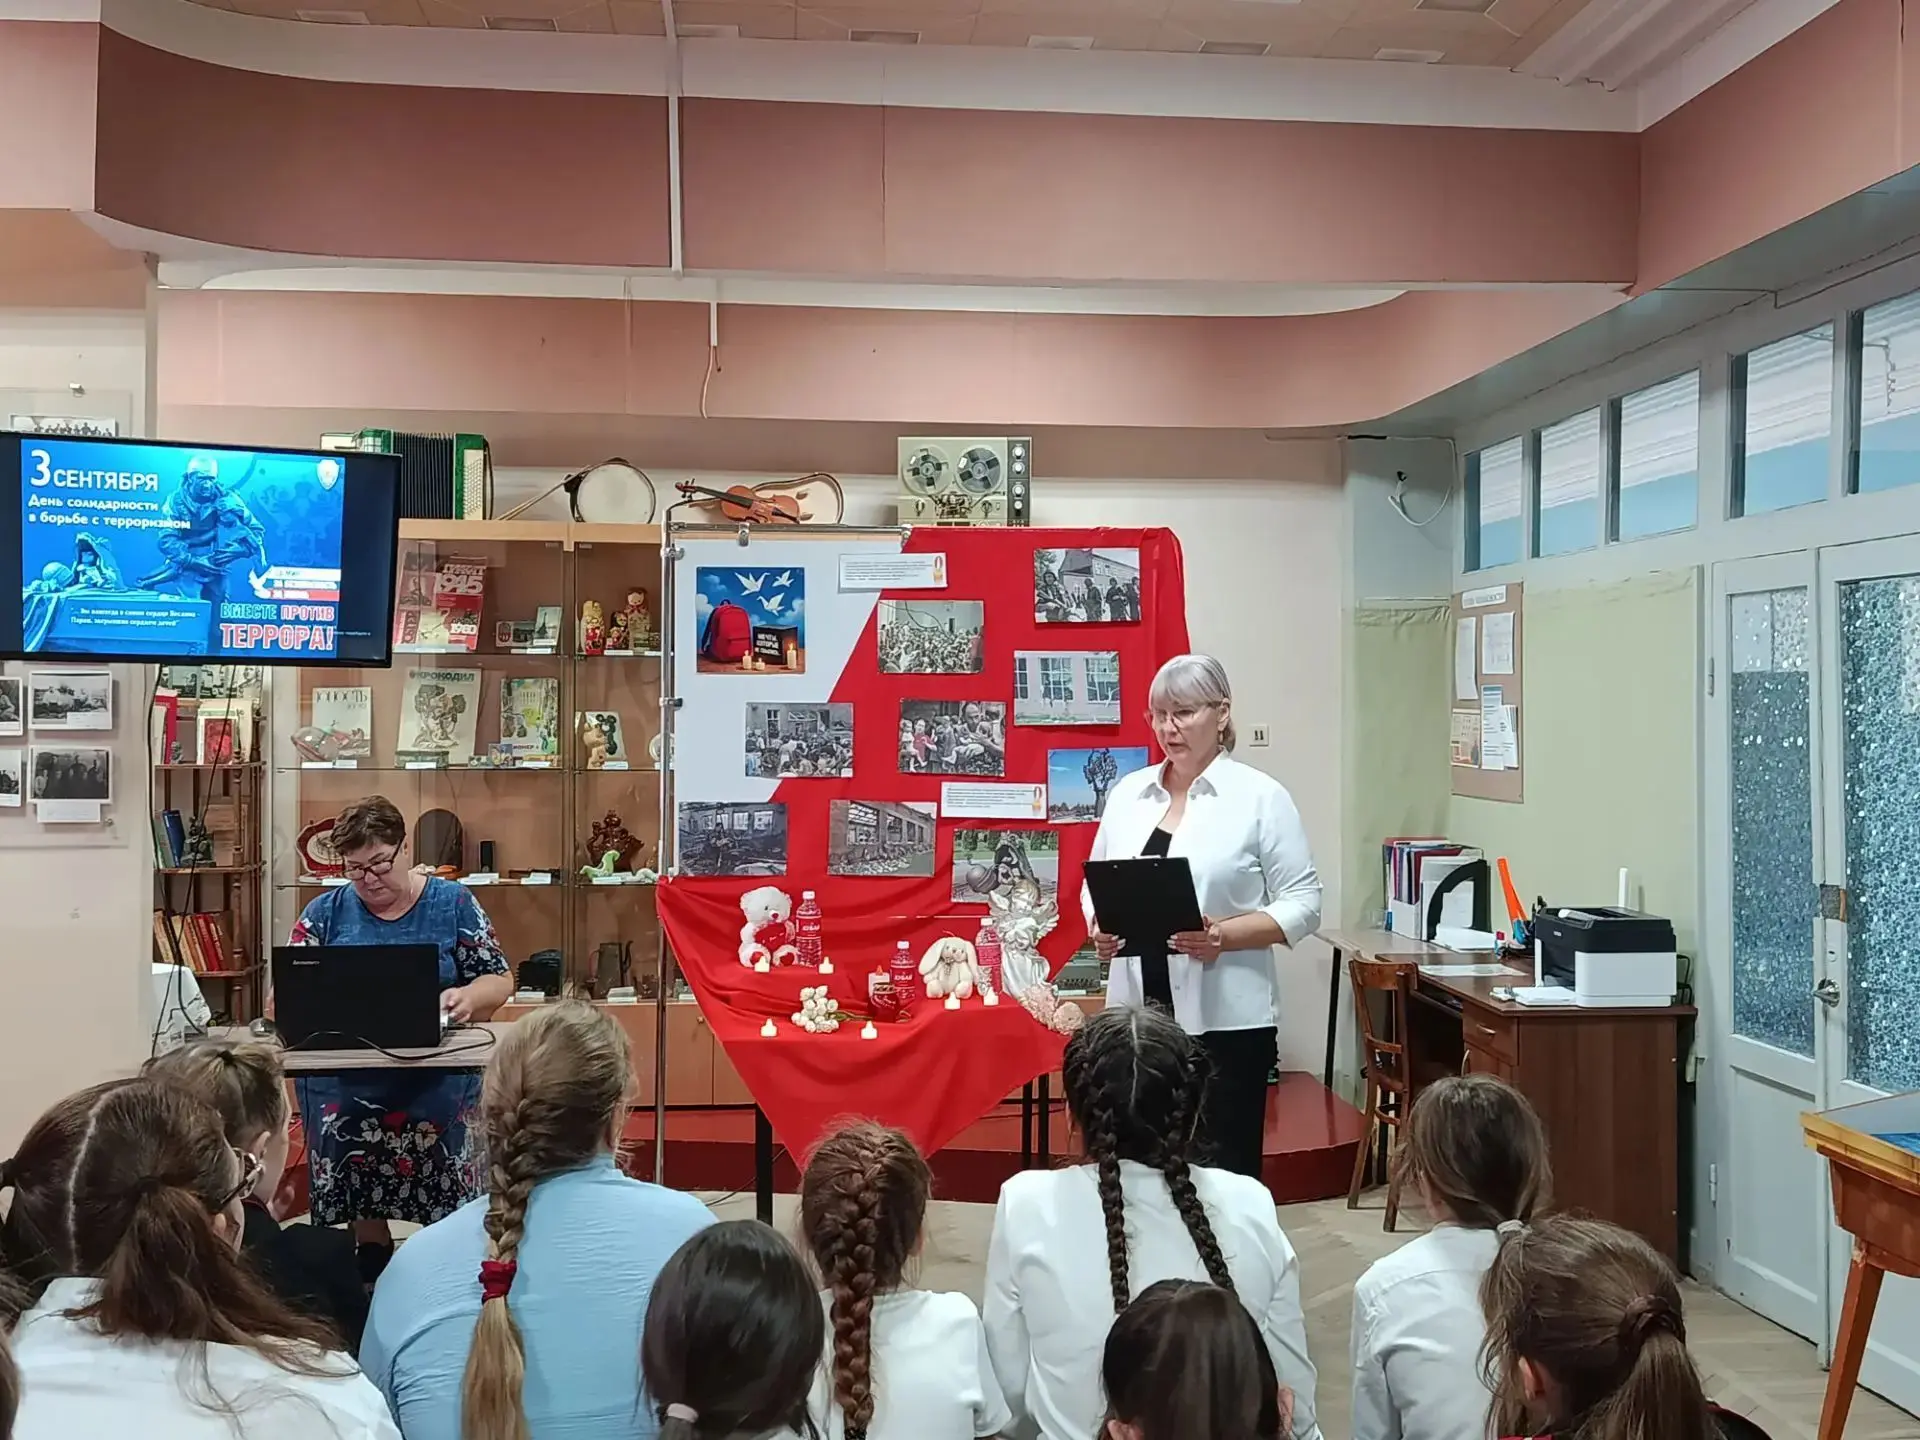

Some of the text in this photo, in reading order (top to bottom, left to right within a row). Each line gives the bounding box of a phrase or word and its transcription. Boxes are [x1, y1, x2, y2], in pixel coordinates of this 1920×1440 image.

[30, 448, 158, 491] 3 СЕНТЯБРЯ
[28, 493, 159, 512] День солидарности
[28, 511, 191, 530] в борьбе с терроризмом
[434, 572, 484, 595] 1945
[220, 602, 335, 621] ВМЕСТЕ ПРОТИВ
[220, 623, 334, 650] ТЕРРОРА!
[416, 671, 475, 682] КРОКОДИЛ
